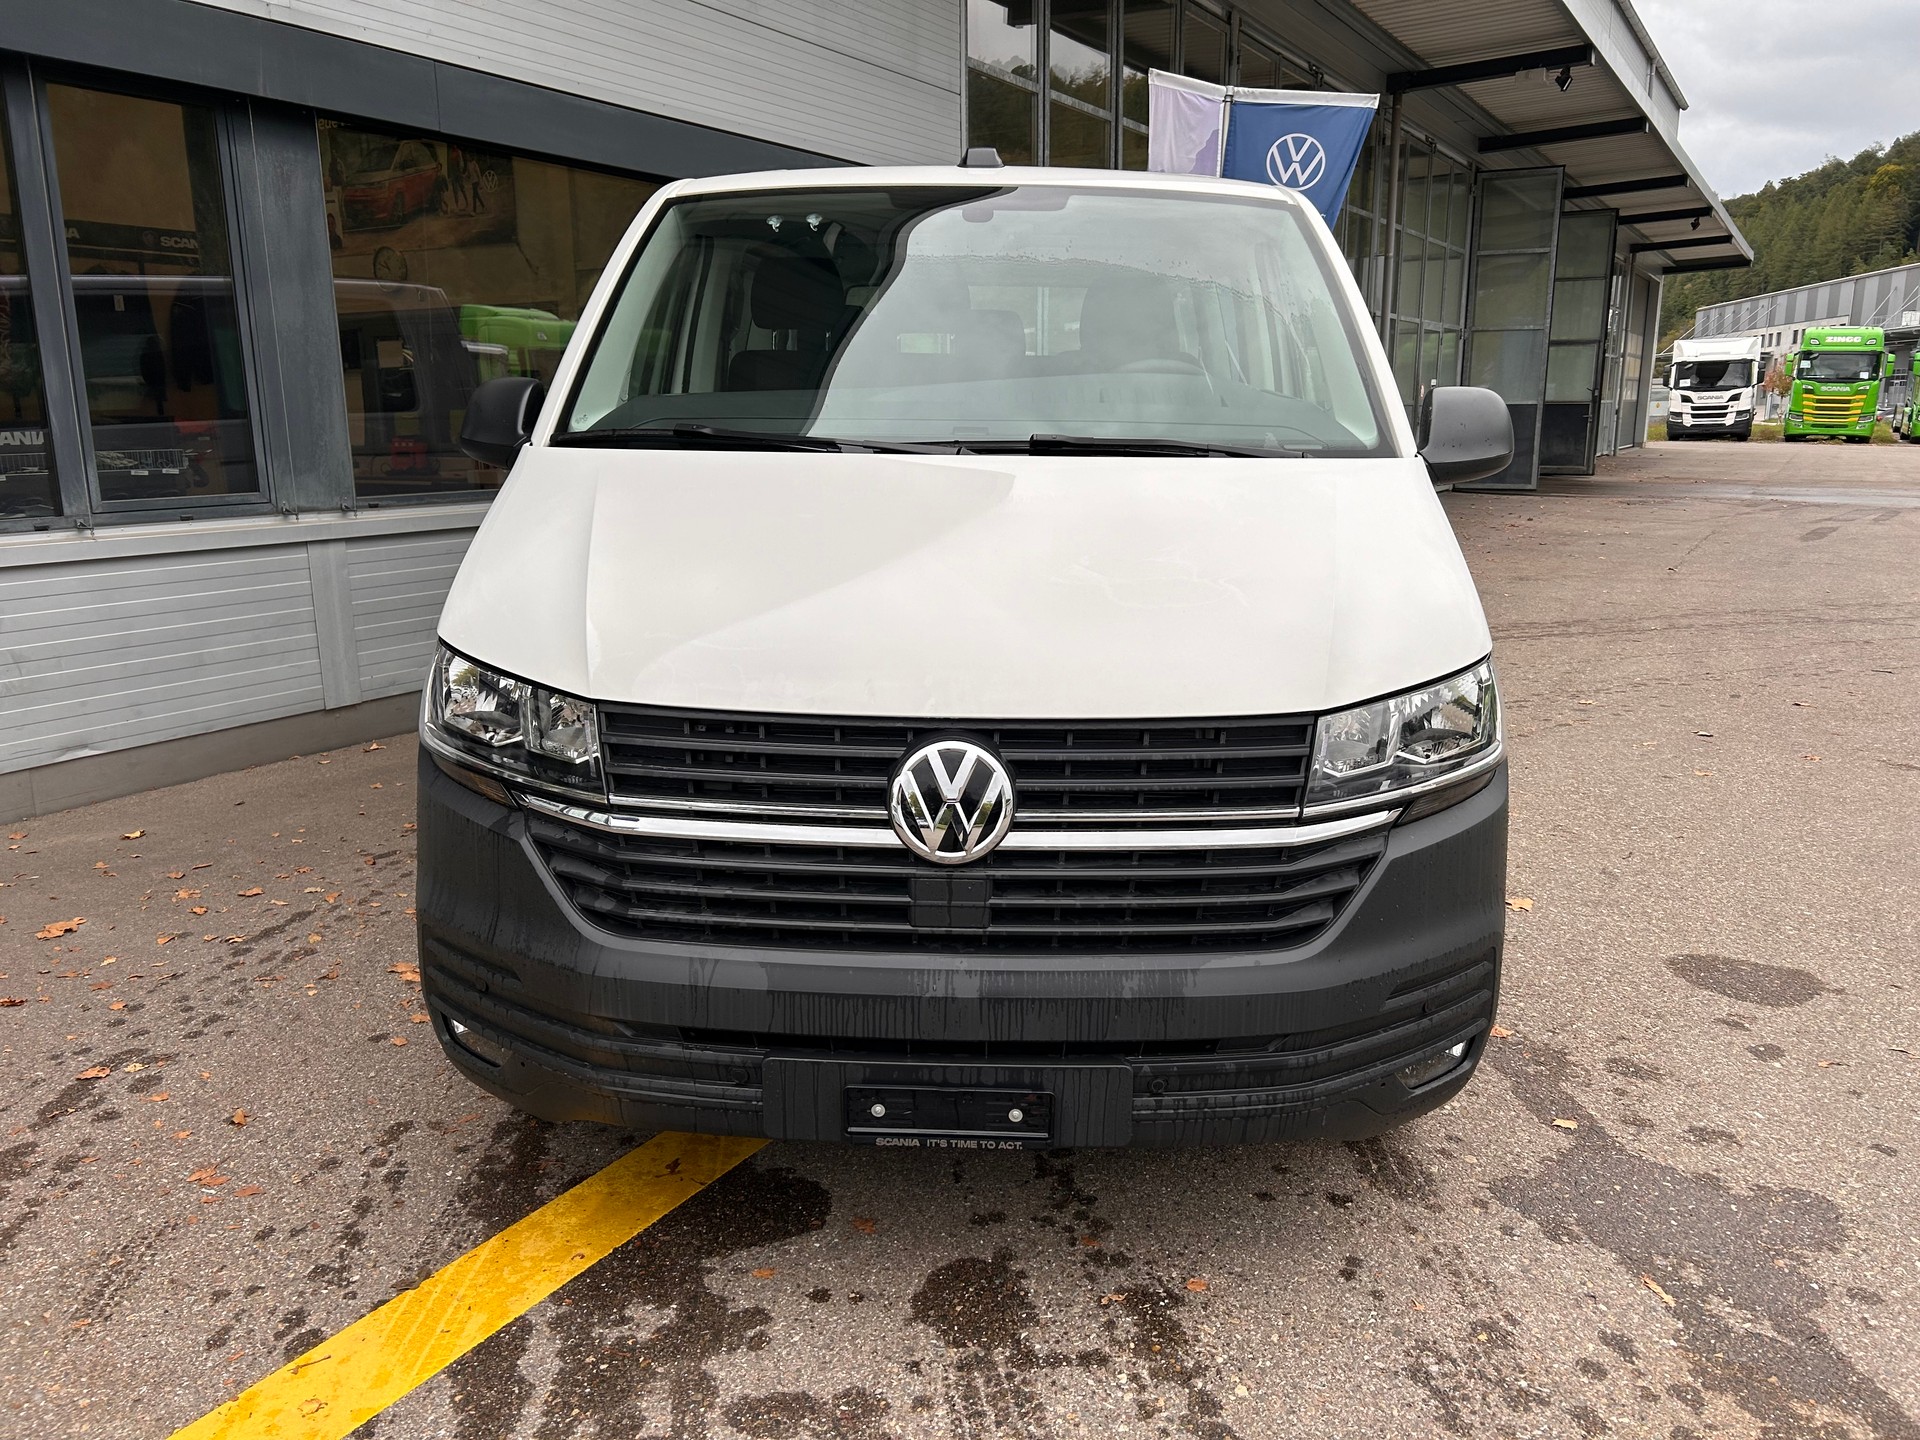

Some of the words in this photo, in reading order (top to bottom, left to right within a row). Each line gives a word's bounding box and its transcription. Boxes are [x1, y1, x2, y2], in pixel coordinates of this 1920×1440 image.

[876, 1137, 920, 1146] SCANIA
[926, 1139, 948, 1148] IT'S
[949, 1140, 977, 1149] TIME
[979, 1141, 996, 1149] TO
[998, 1141, 1023, 1150] ACT.
